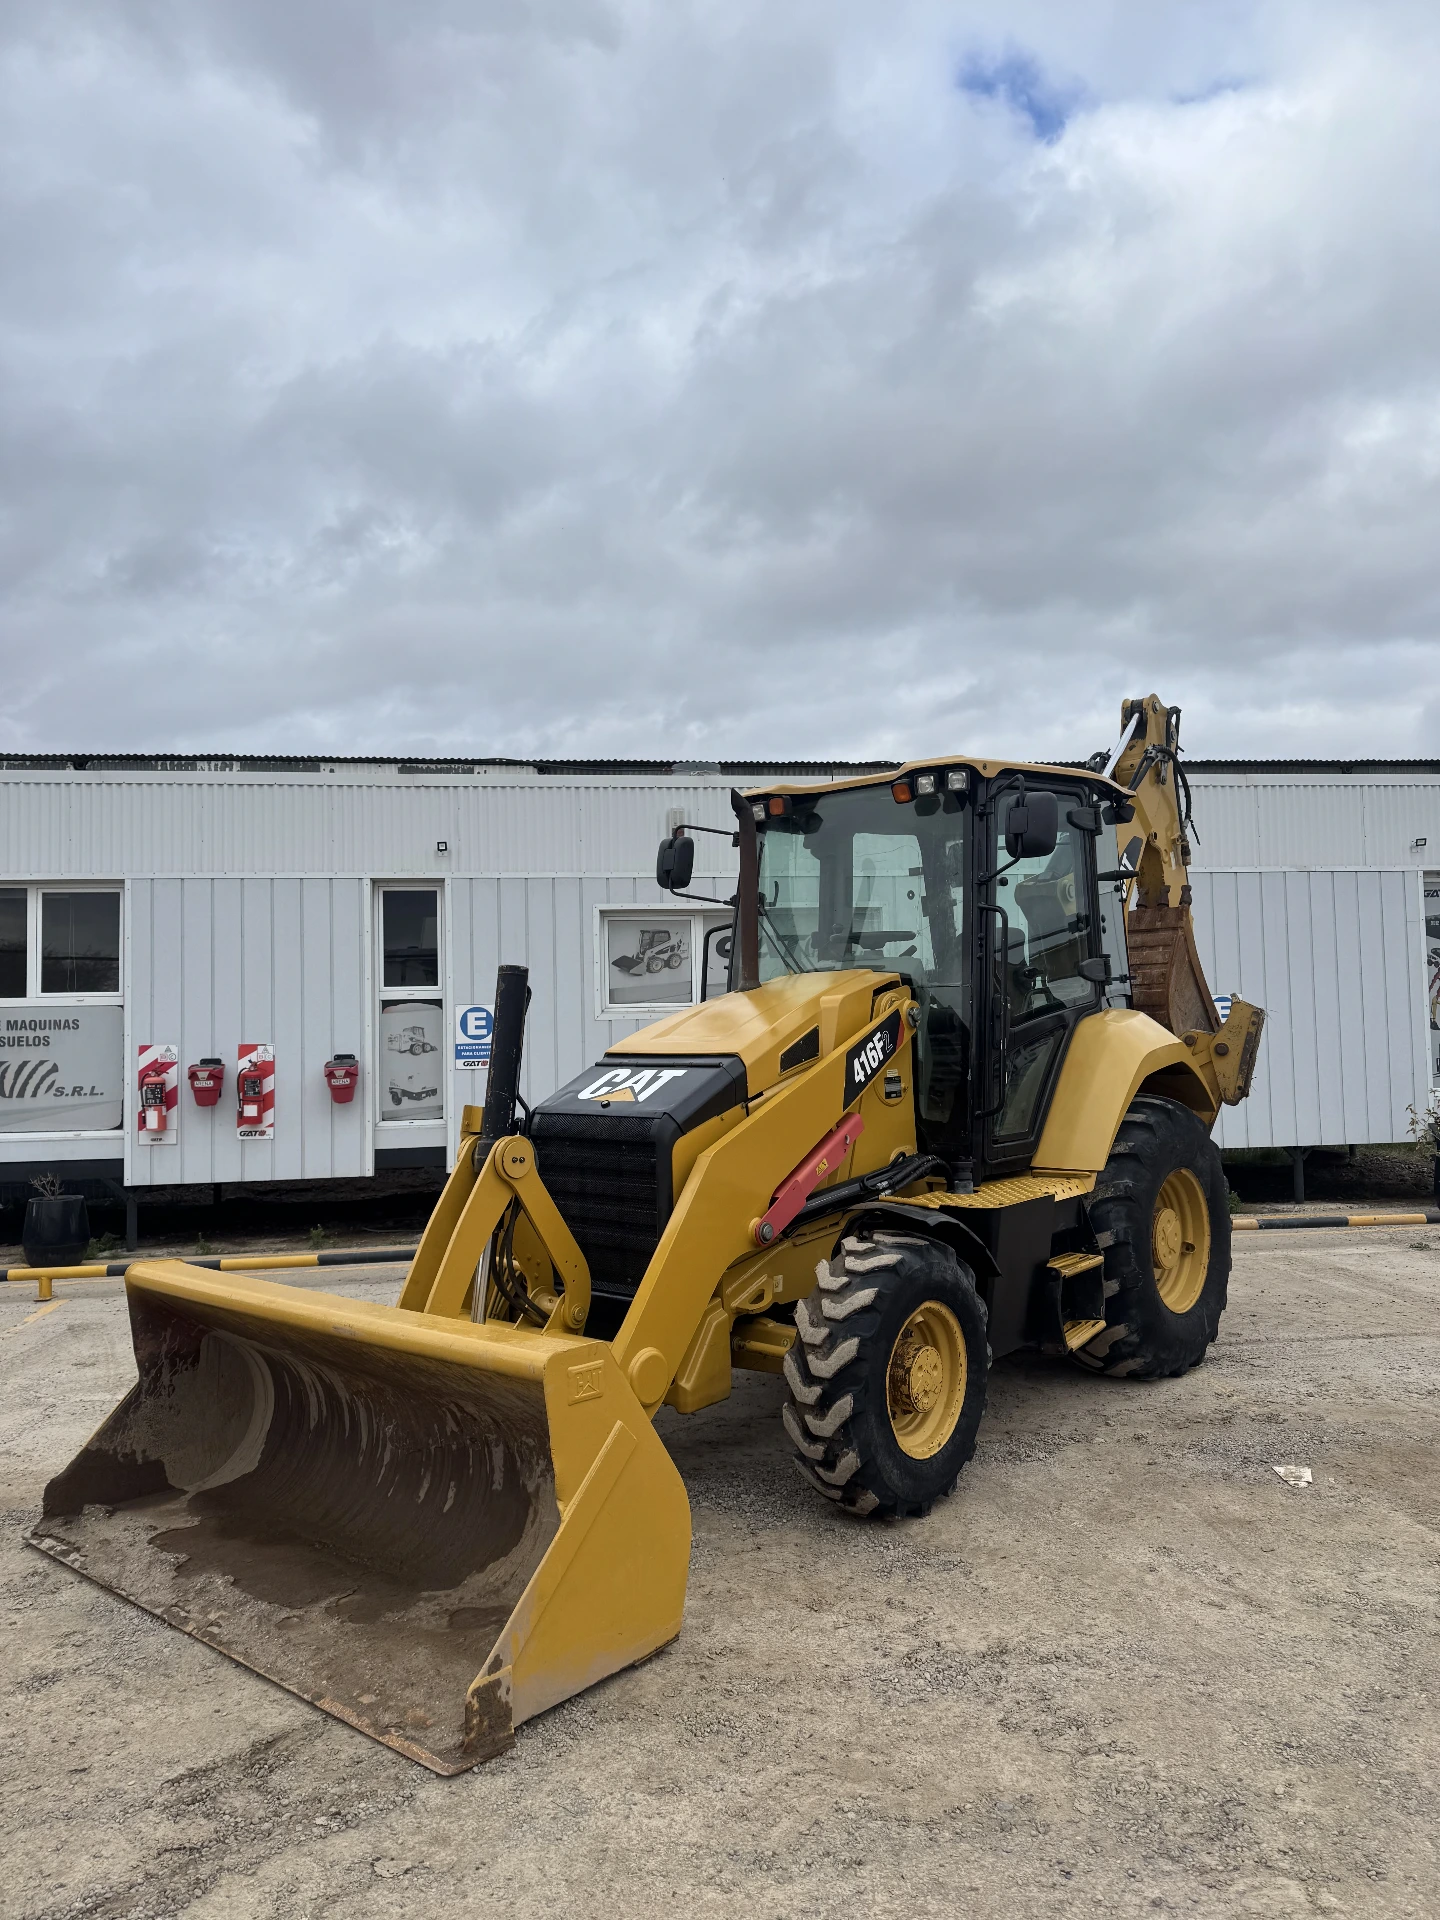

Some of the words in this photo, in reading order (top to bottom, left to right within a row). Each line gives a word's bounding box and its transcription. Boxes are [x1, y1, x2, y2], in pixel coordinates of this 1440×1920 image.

[6, 1019, 80, 1032] MAQUINAS
[467, 1012, 488, 1035] E
[0, 1035, 51, 1048] SUELOS
[53, 1086, 104, 1097] S.R.L.
[578, 1068, 688, 1102] CAT
